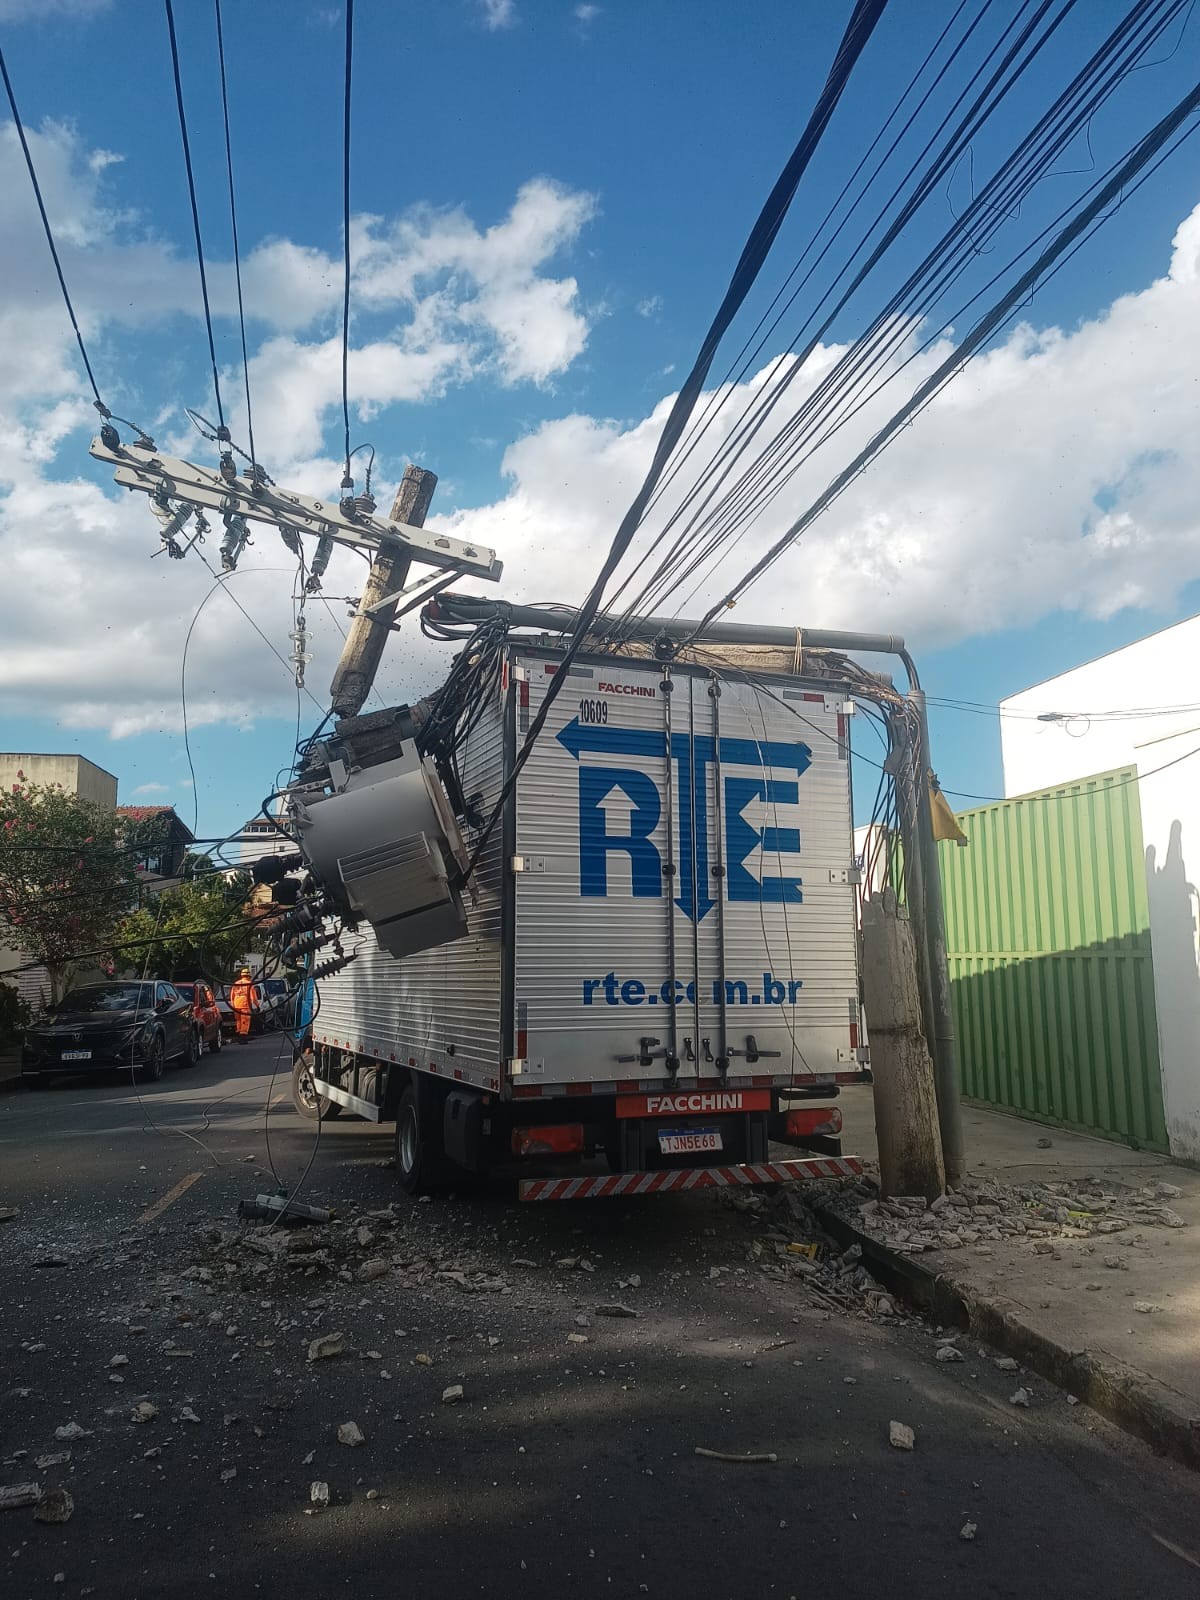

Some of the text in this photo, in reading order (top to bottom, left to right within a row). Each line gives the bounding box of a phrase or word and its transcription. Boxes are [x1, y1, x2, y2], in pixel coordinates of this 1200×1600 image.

[598, 682, 656, 698] FACCHINI
[579, 698, 608, 724] 10609
[647, 1093, 743, 1113] FACCHINI
[665, 1134, 716, 1151] TJN5E68
